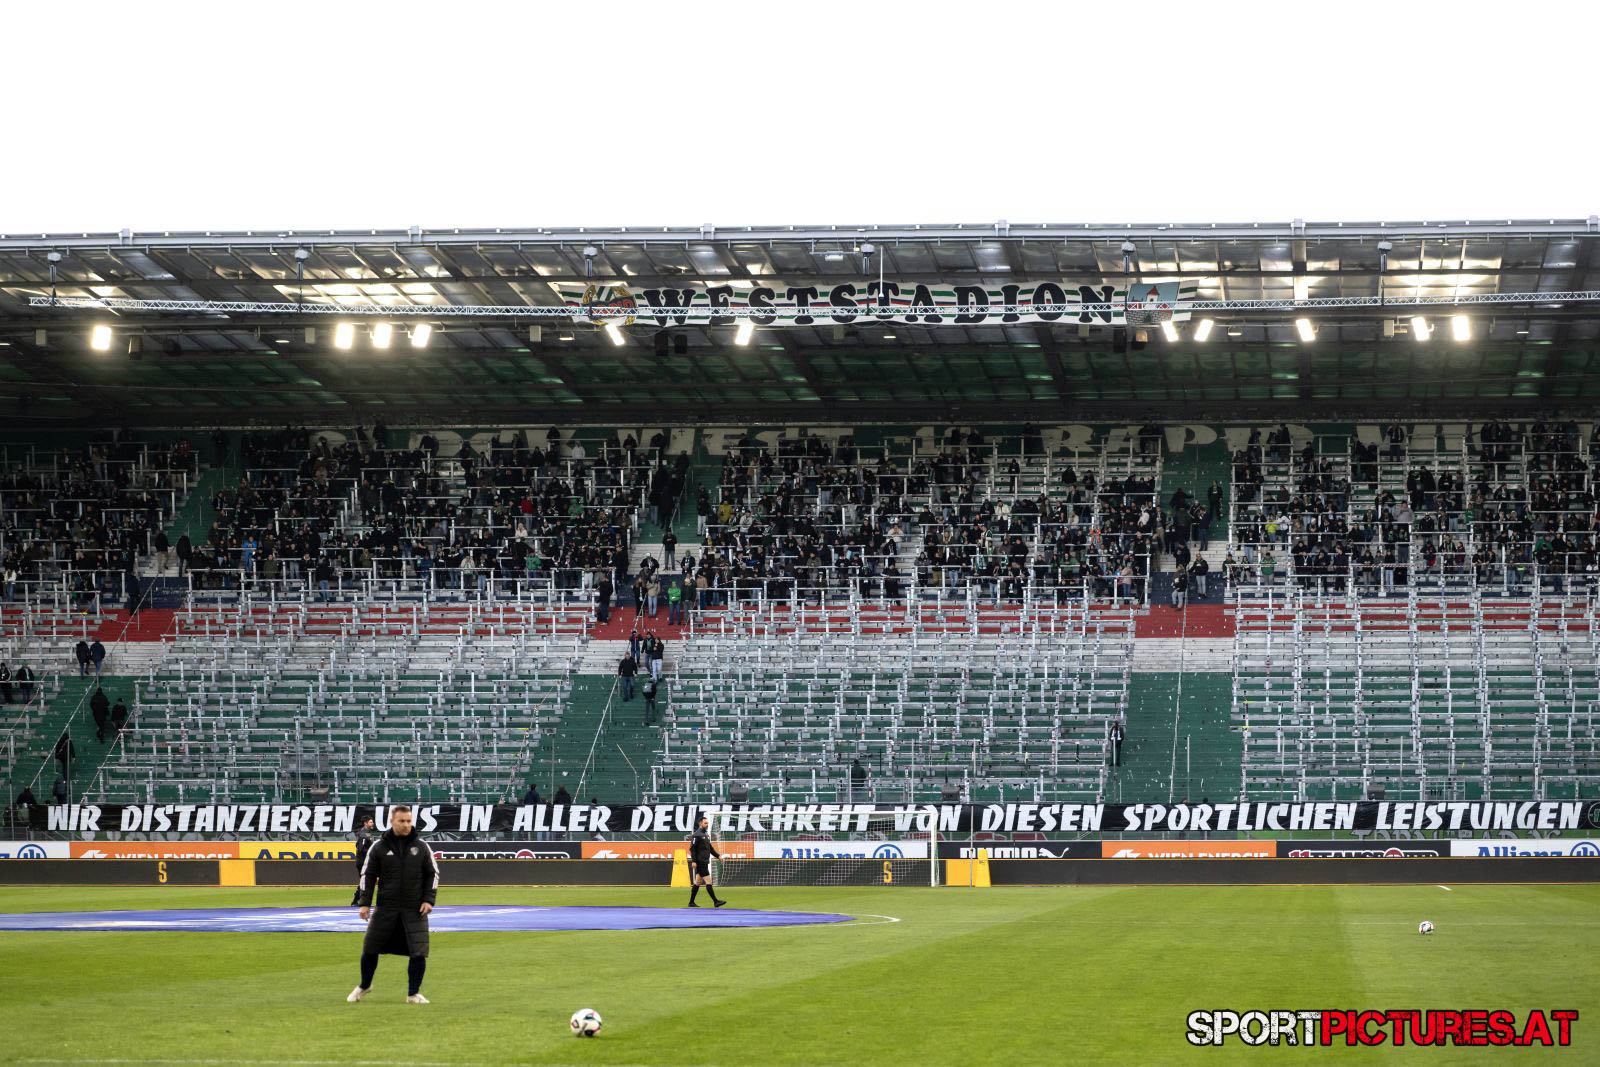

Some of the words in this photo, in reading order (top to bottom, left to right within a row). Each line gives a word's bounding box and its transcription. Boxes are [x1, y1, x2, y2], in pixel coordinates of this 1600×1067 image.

[643, 282, 1115, 325] WESTSTADION
[48, 804, 101, 831] WIR
[120, 805, 355, 831] DISTANZIEREN
[375, 804, 440, 832] US
[459, 804, 493, 831] IN
[512, 804, 612, 831] ALLER
[630, 804, 875, 831] DEUTLICHKEIT
[894, 804, 962, 831] VON
[981, 804, 1104, 831] DIESEN
[1123, 803, 1357, 831] SPORTLICHEN
[1376, 802, 1582, 829] LEISTUNGEN
[158, 861, 168, 883] S
